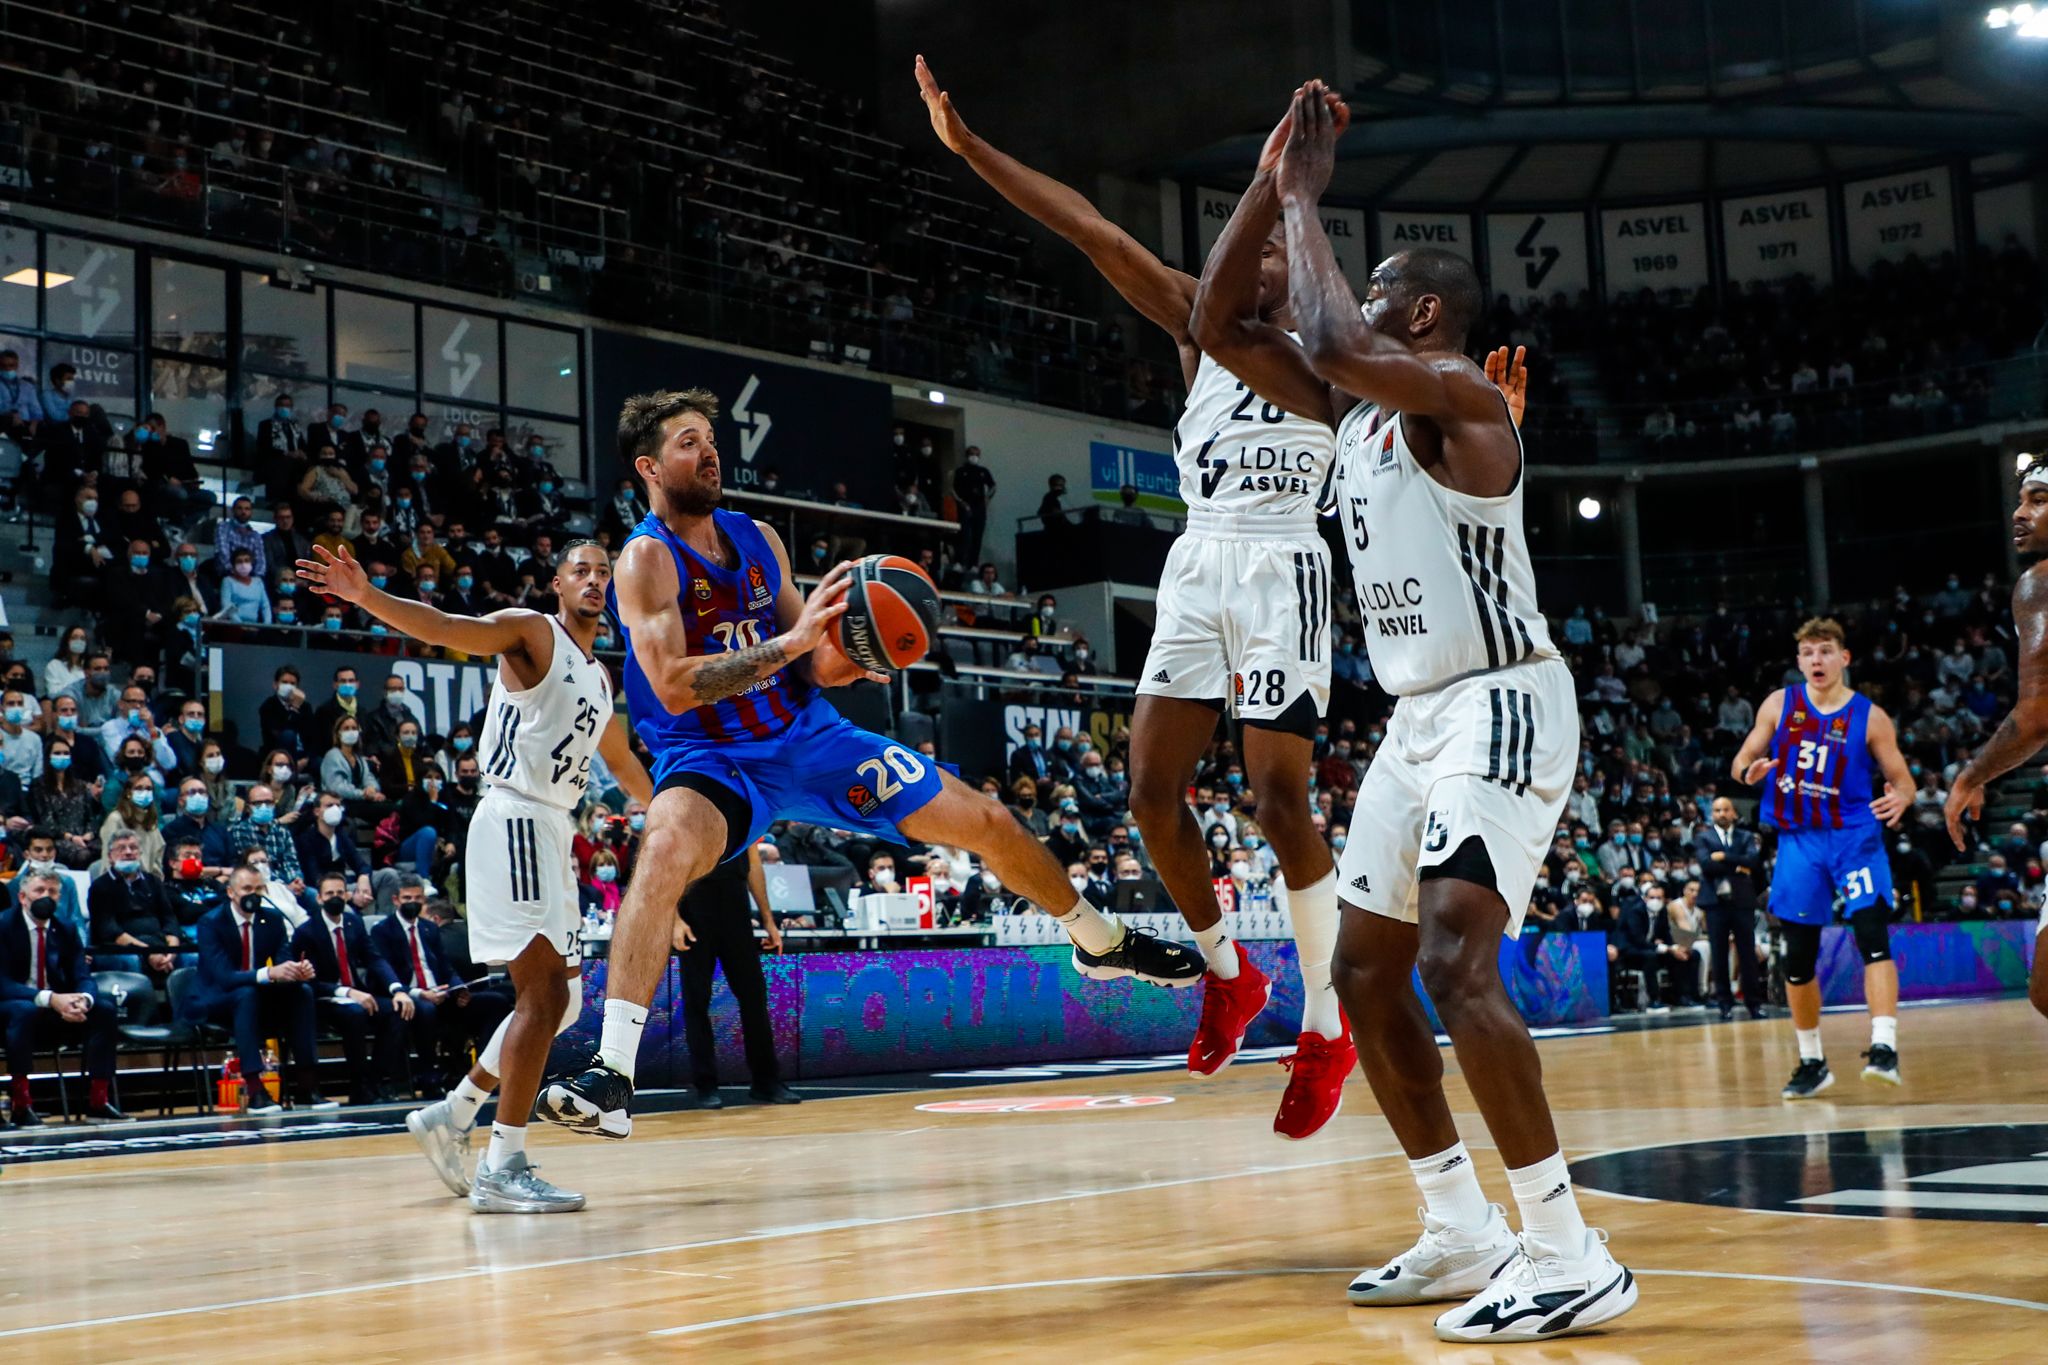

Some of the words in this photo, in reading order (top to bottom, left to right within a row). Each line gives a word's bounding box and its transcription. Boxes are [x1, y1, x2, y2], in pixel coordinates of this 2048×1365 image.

[1861, 181, 1935, 209] ASVEL
[1739, 202, 1813, 226] ASVEL
[1394, 223, 1458, 242] ASVEL
[1618, 216, 1690, 237] ASVEL
[1879, 222, 1923, 243] 1972
[1758, 241, 1797, 260] 1971
[1633, 255, 1678, 272] 1969
[71, 349, 120, 368] LDLC
[443, 407, 482, 425] LDLC
[1239, 446, 1315, 473] LDLC
[733, 466, 760, 486] LDL
[1239, 475, 1310, 495] ASVEL
[1350, 497, 1369, 551] 5
[1361, 577, 1423, 611] LDLC
[1377, 613, 1428, 637] ASVEL
[1247, 669, 1286, 706] 28
[574, 697, 599, 738] 25
[1797, 740, 1829, 774] 31
[856, 745, 926, 803] 20
[1425, 809, 1449, 852] 5
[1846, 866, 1874, 900] 31
